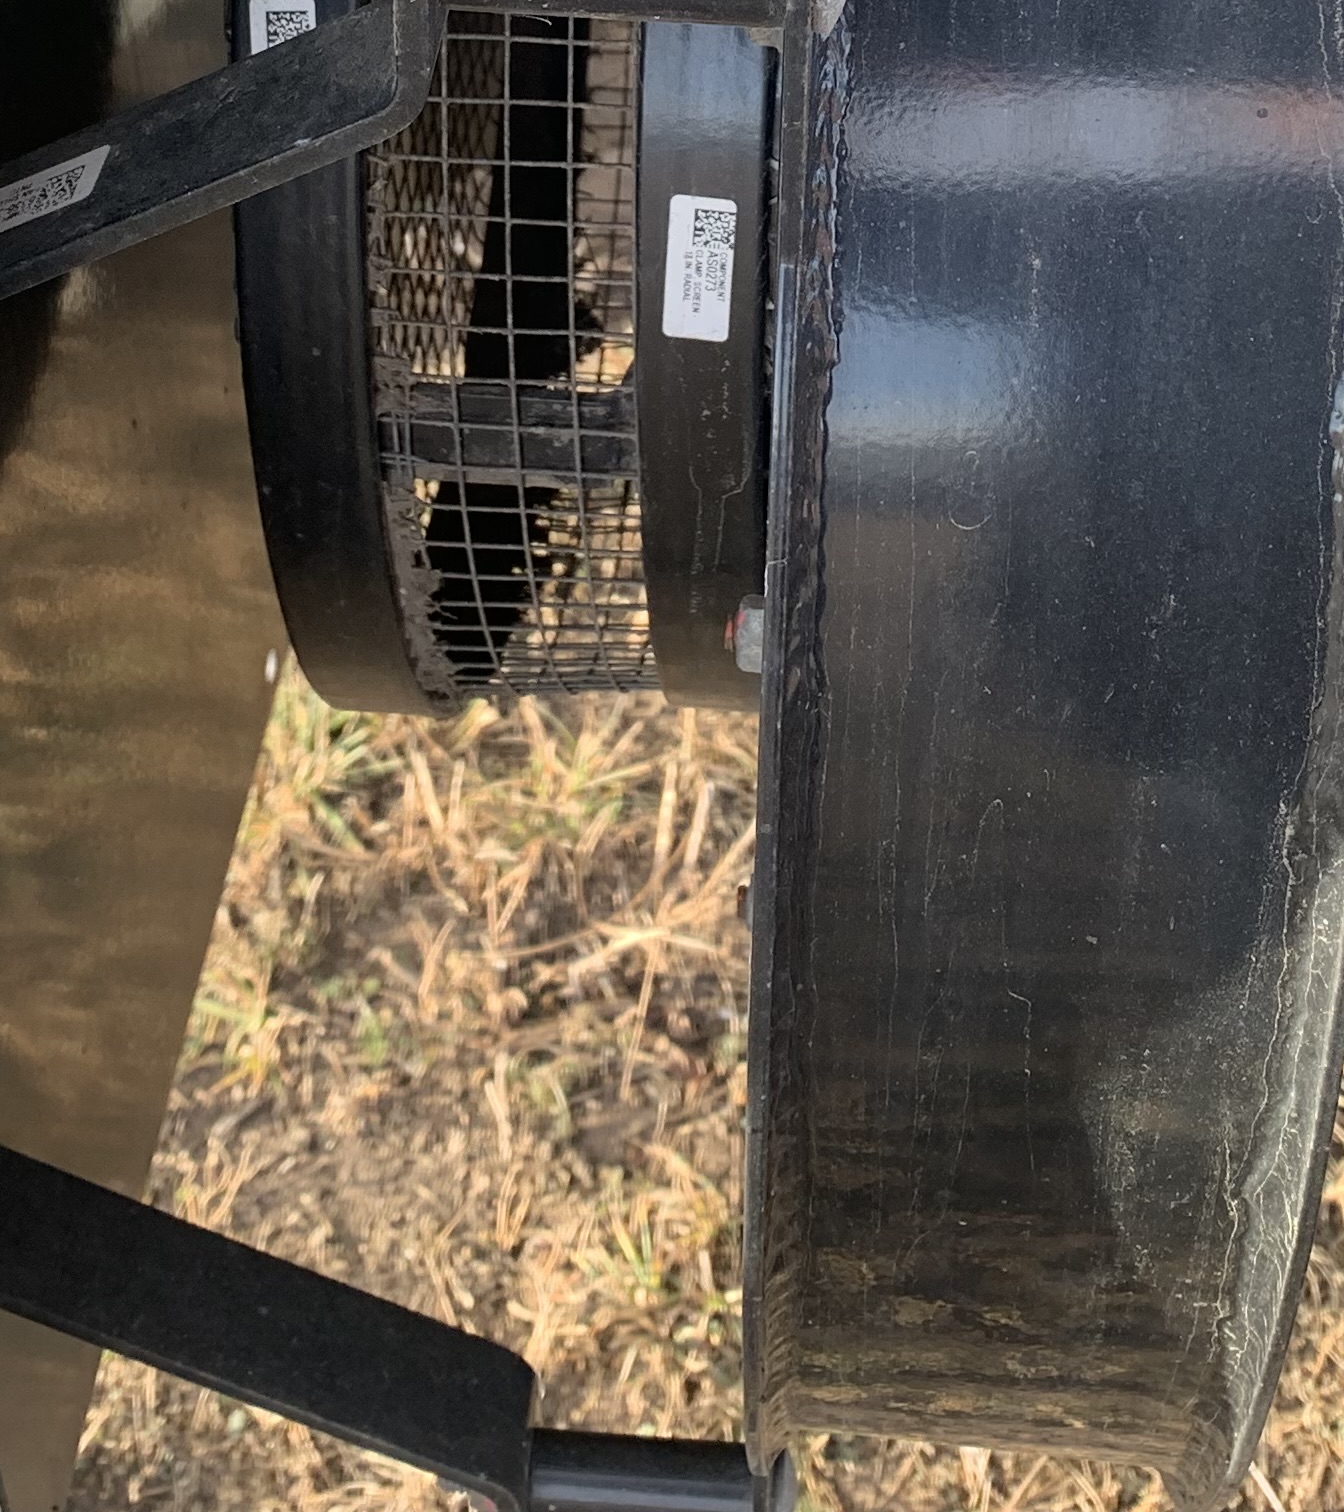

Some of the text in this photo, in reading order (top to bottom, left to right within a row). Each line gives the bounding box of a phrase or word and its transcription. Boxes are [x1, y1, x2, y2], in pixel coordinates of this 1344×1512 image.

[682, 273, 692, 302] RADIAL
[704, 249, 718, 292] AS0273
[717, 252, 728, 302] COMPONENT
[692, 281, 702, 314] SCREEN
